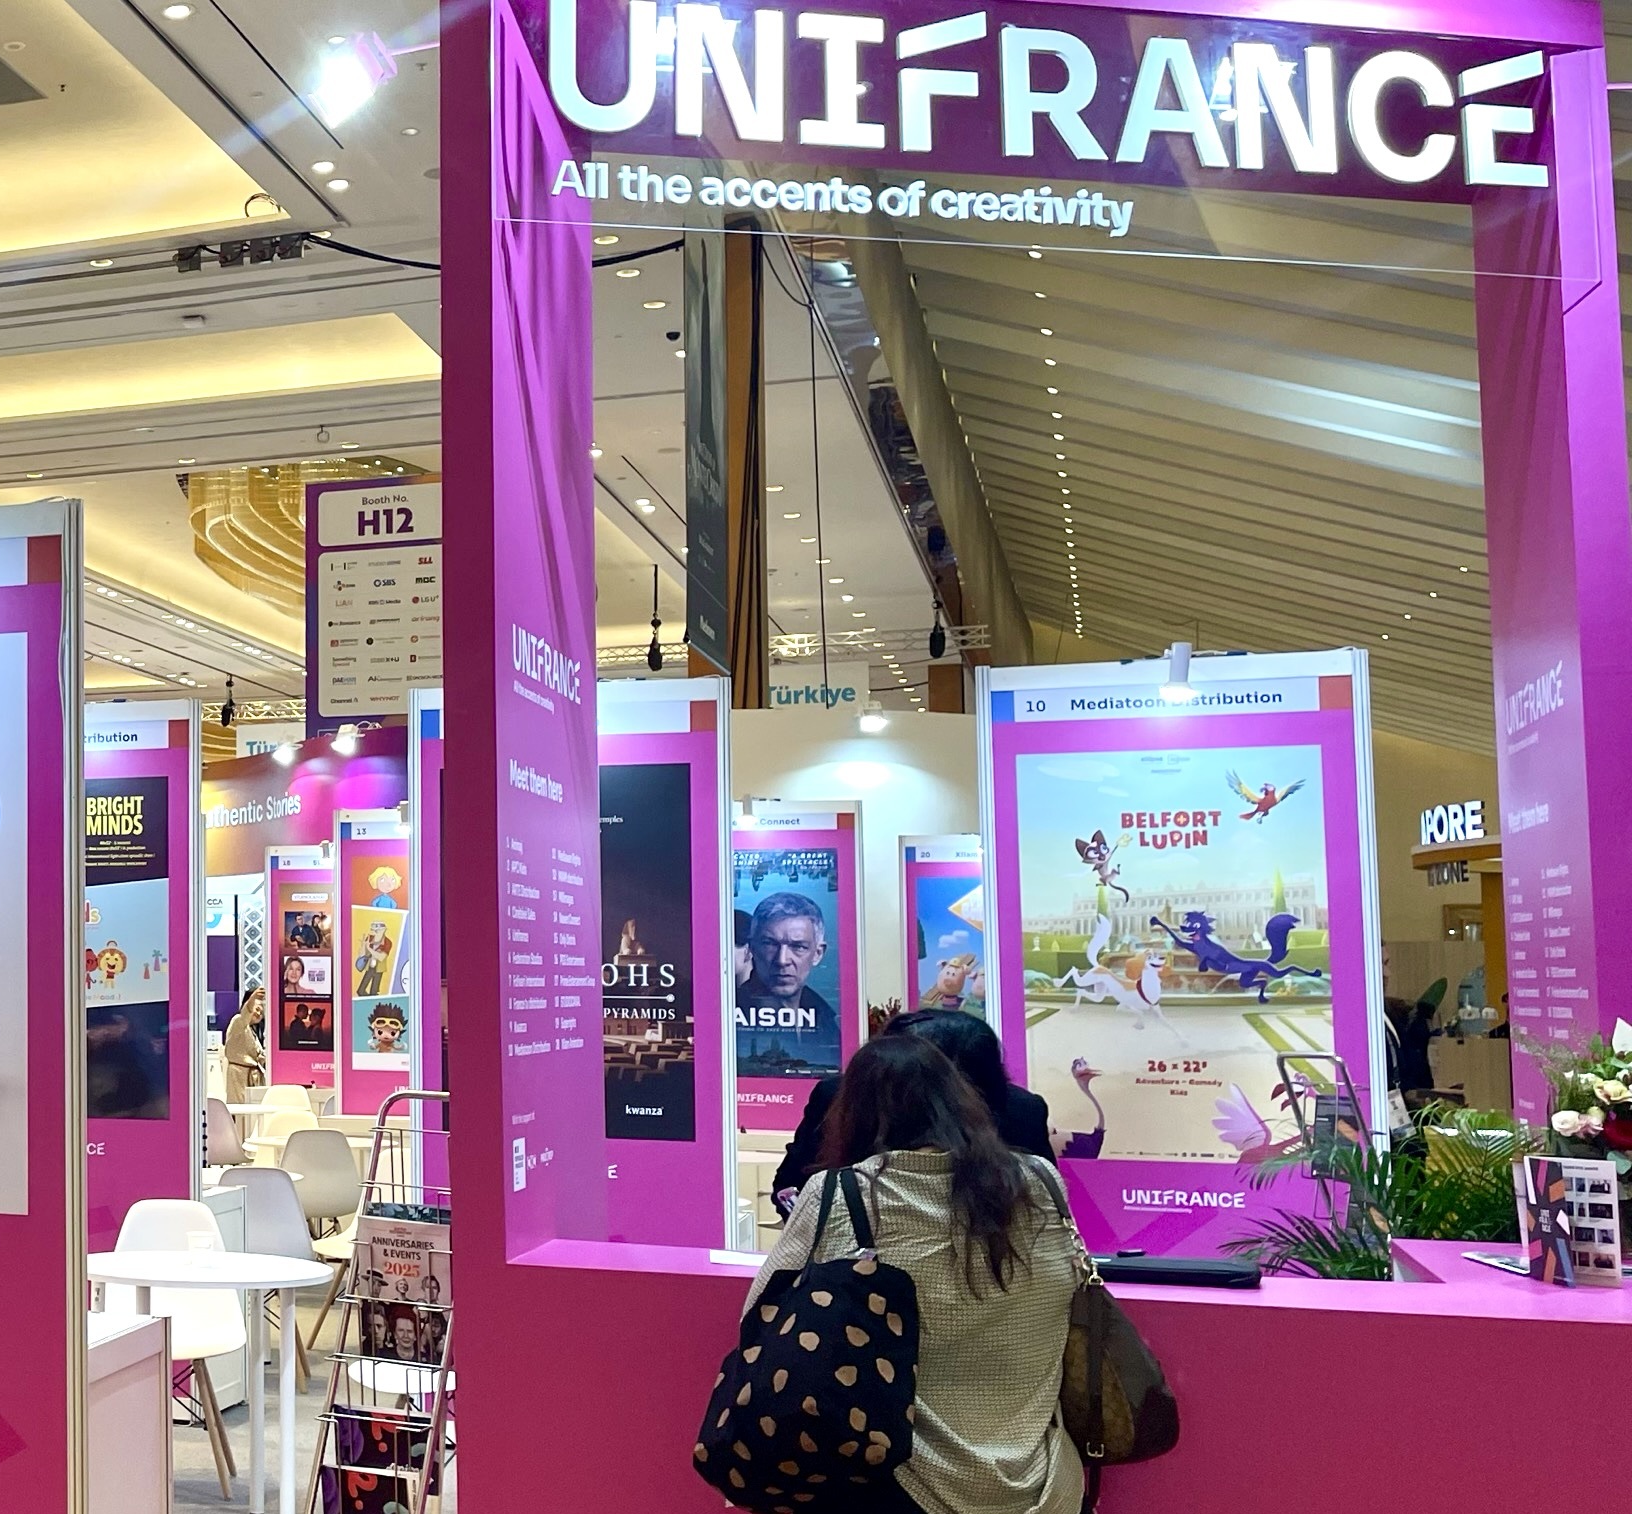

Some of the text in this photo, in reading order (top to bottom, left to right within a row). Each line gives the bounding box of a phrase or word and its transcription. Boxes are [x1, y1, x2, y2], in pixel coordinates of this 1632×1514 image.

[552, 159, 1134, 239] All the accents of creativity
[362, 494, 409, 506] Booth No.
[357, 507, 415, 537] H12
[418, 557, 433, 565] SLL
[768, 683, 856, 708] Türkiye
[1070, 691, 1283, 711] Mediatoon stribution
[1026, 700, 1046, 713] 10
[84, 732, 138, 743] tribution
[509, 758, 563, 804] Meet them here
[86, 795, 144, 816] BRIGHT
[266, 791, 302, 820] Stories
[85, 814, 144, 836] MINDS
[599, 815, 624, 825] emples
[1120, 811, 1222, 829] BELFORT
[1139, 830, 1208, 850] LUPIN
[601, 963, 675, 987] OHS
[603, 1007, 676, 1020] PYRAMIDS
[735, 1007, 816, 1028] AISON
[1148, 1060, 1167, 1073] 26
[737, 1093, 794, 1104] NIFRANCE
[625, 1104, 664, 1115] kwanza
[371, 1235, 435, 1250] ANNIVERSARIES
[383, 1248, 422, 1261] & EVENTS
[384, 1261, 420, 1278] 2025
